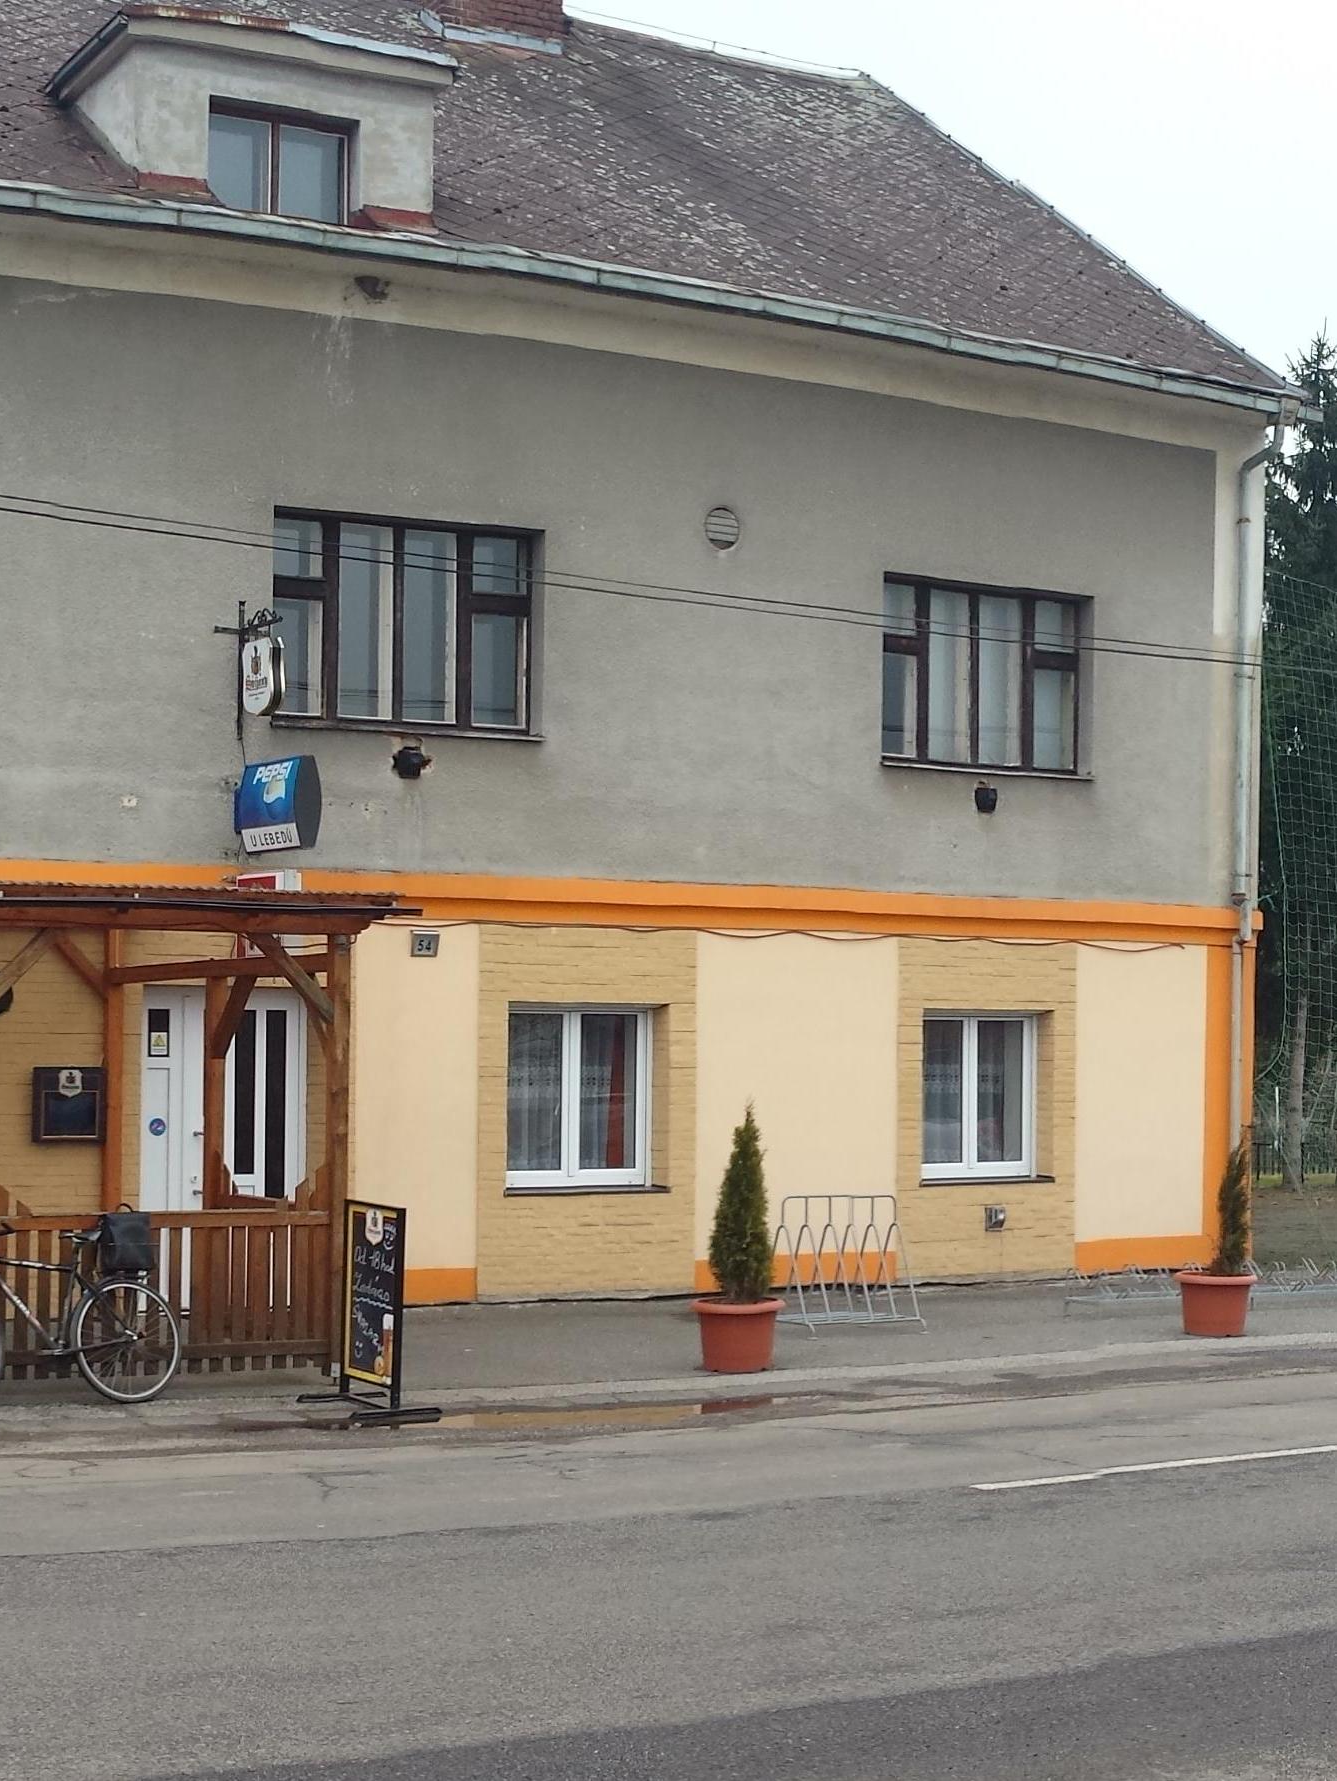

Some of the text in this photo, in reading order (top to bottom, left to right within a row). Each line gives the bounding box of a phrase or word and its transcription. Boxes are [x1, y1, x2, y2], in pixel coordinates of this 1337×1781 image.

[253, 762, 293, 784] PEPSI
[250, 835, 257, 847] U
[418, 939, 431, 952] 54
